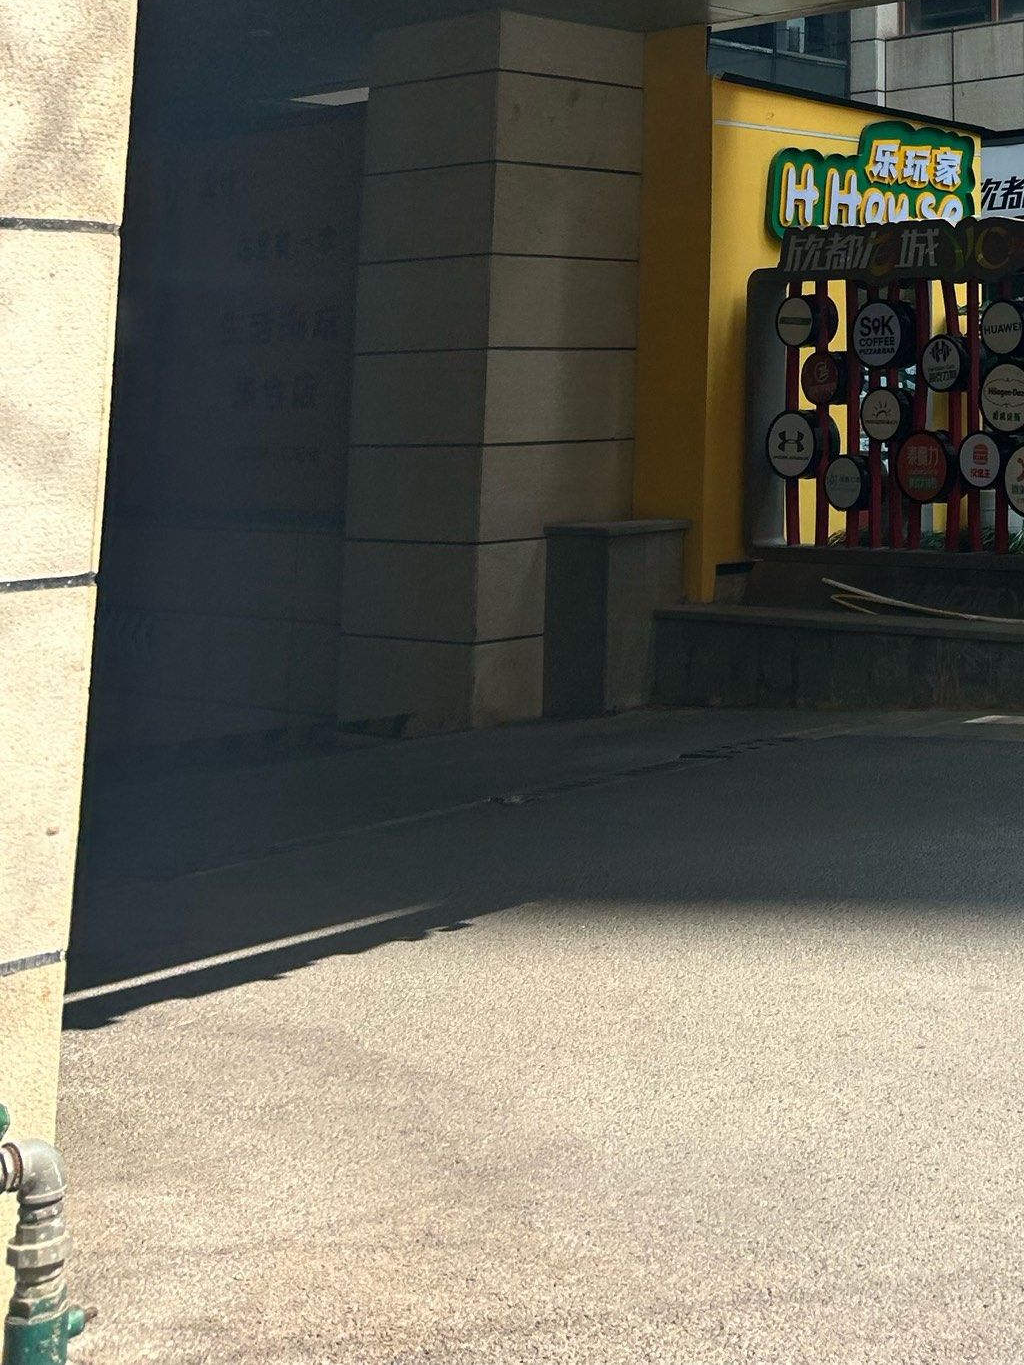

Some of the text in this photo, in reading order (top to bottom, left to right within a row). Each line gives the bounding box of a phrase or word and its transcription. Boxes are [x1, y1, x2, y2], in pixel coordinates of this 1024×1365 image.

[868, 140, 962, 188] 乐玩家
[983, 322, 1023, 336] HUAWEI
[859, 336, 895, 347] COFFEE
